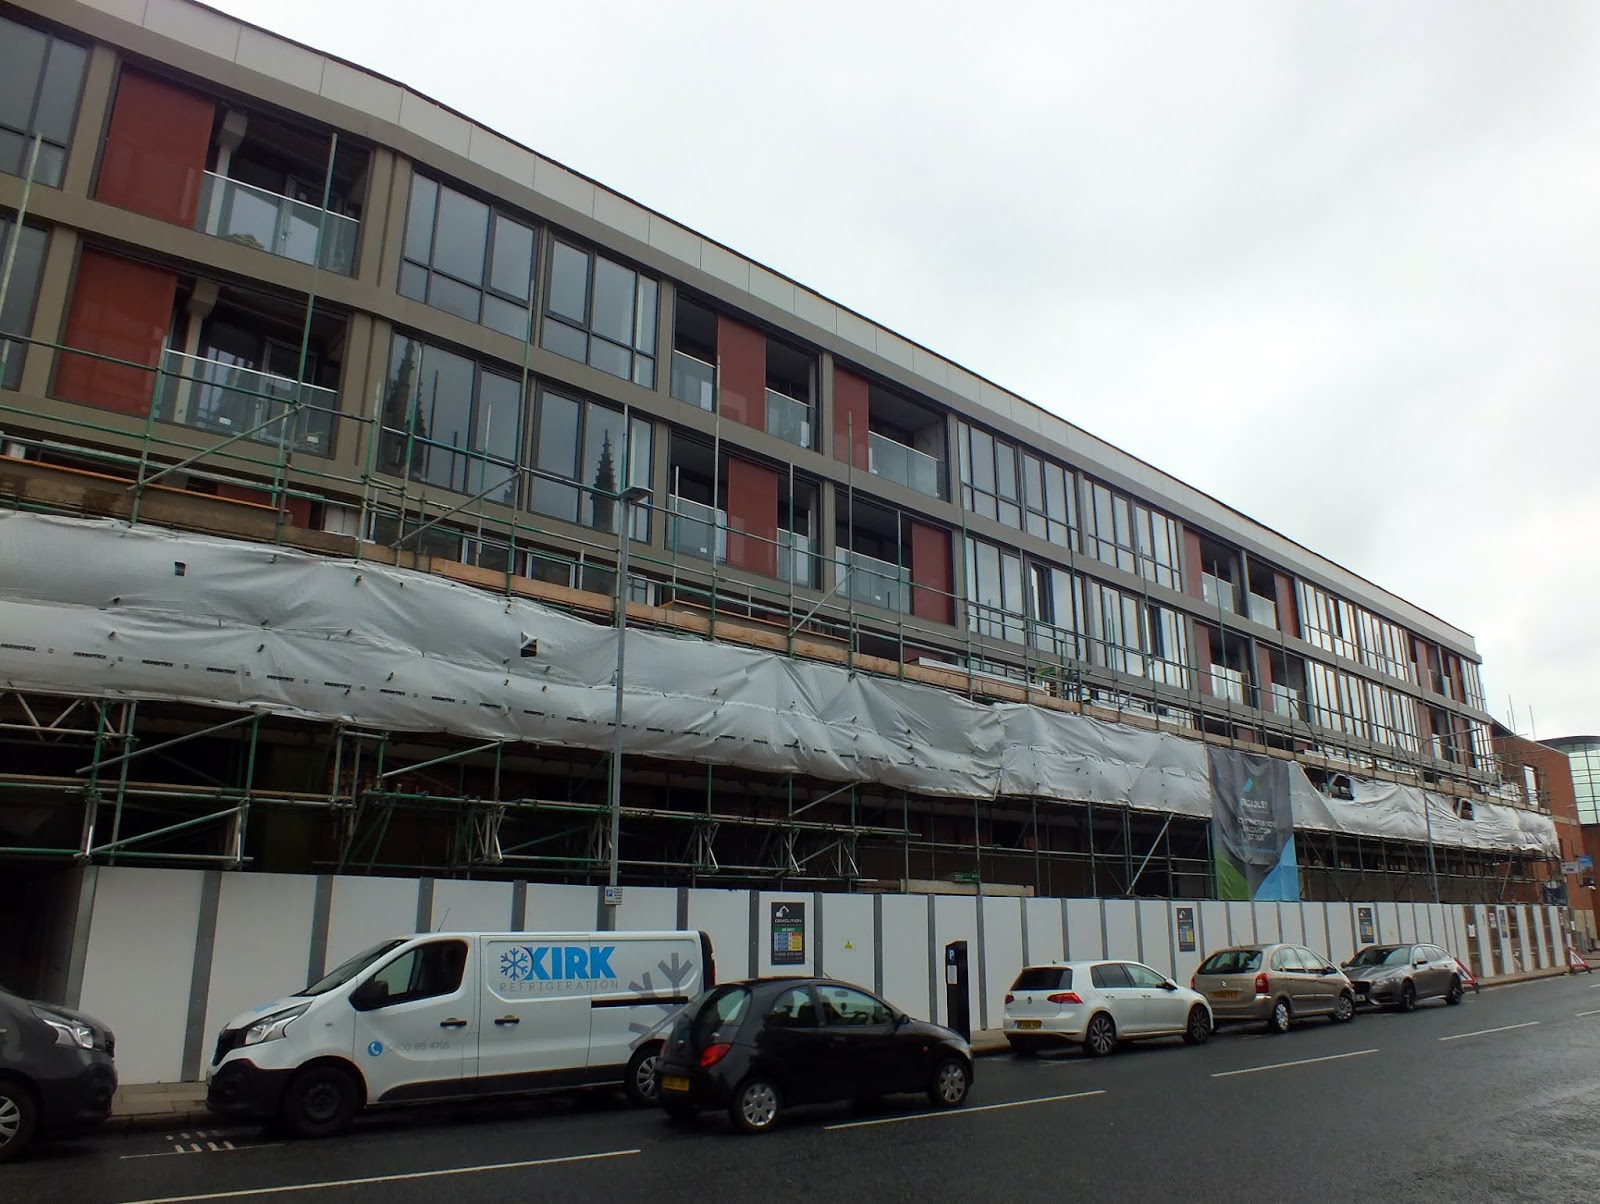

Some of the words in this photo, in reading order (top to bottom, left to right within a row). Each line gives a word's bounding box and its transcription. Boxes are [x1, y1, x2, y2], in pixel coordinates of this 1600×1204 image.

[949, 950, 955, 960] P
[520, 946, 617, 981] KIRK
[500, 980, 619, 992] REFRIGERATION
